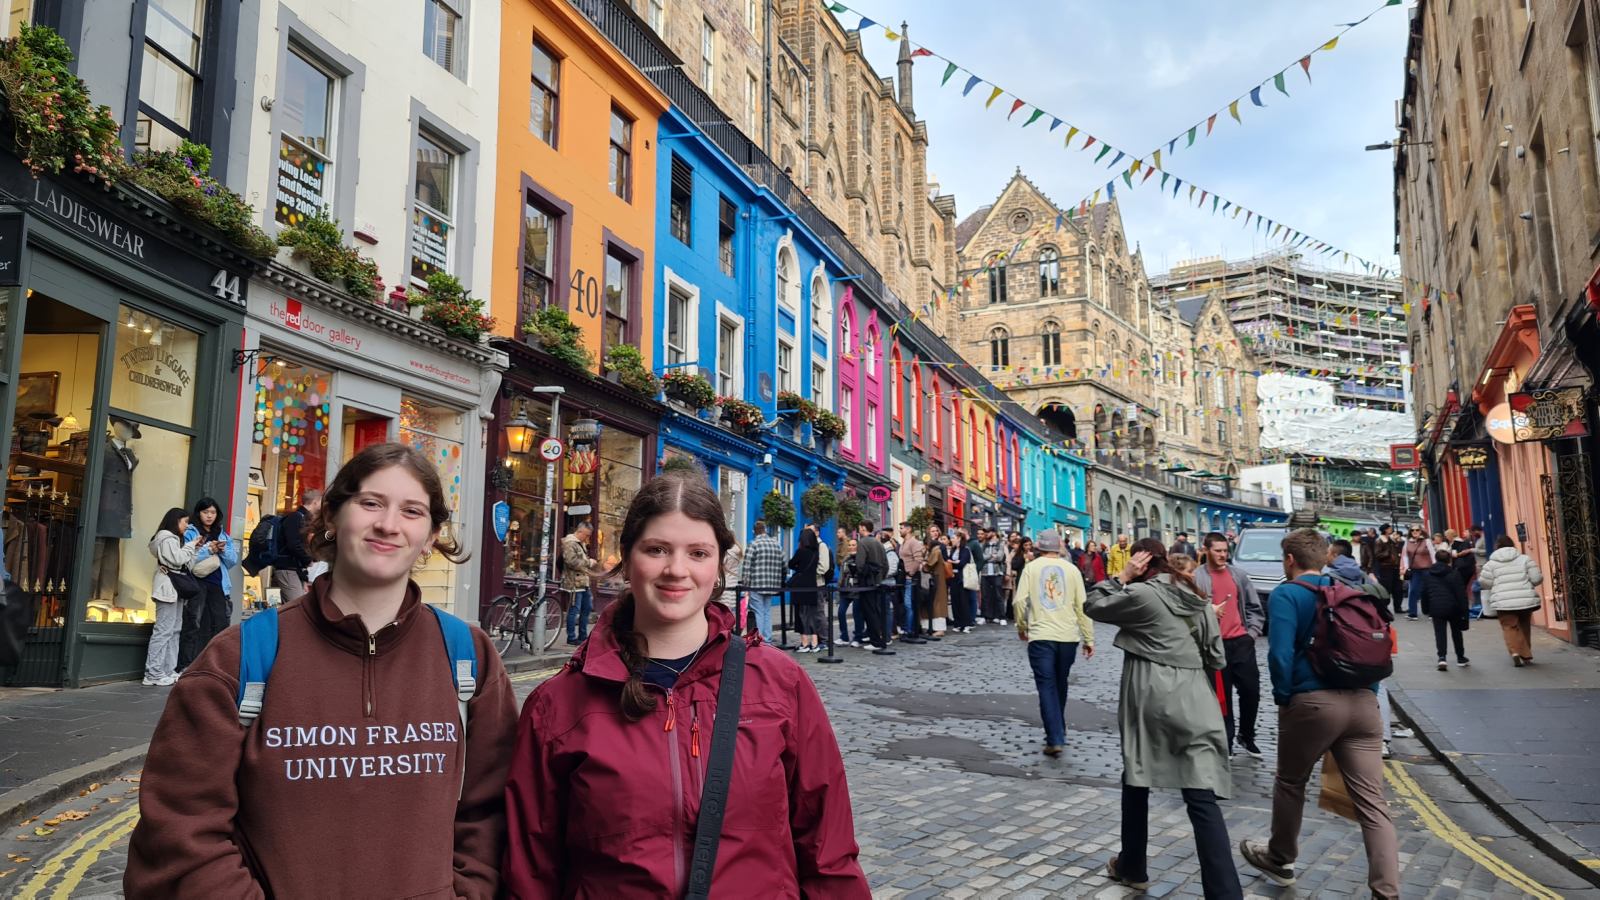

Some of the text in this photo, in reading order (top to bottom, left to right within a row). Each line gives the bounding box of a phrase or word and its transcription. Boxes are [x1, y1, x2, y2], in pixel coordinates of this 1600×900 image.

[279, 160, 321, 191] ving Local
[280, 175, 296, 193] and
[277, 189, 295, 208] ince
[34, 180, 144, 258] LADIESWEAR
[570, 268, 599, 318] 40
[270, 302, 362, 350] the red door gallery
[156, 346, 191, 388] LUGGAGE
[128, 369, 183, 397] CHILDRENSWEAR
[543, 443, 561, 456] 20
[266, 722, 457, 748] SIMON FRASER
[284, 753, 447, 781] UNIVERSITY
